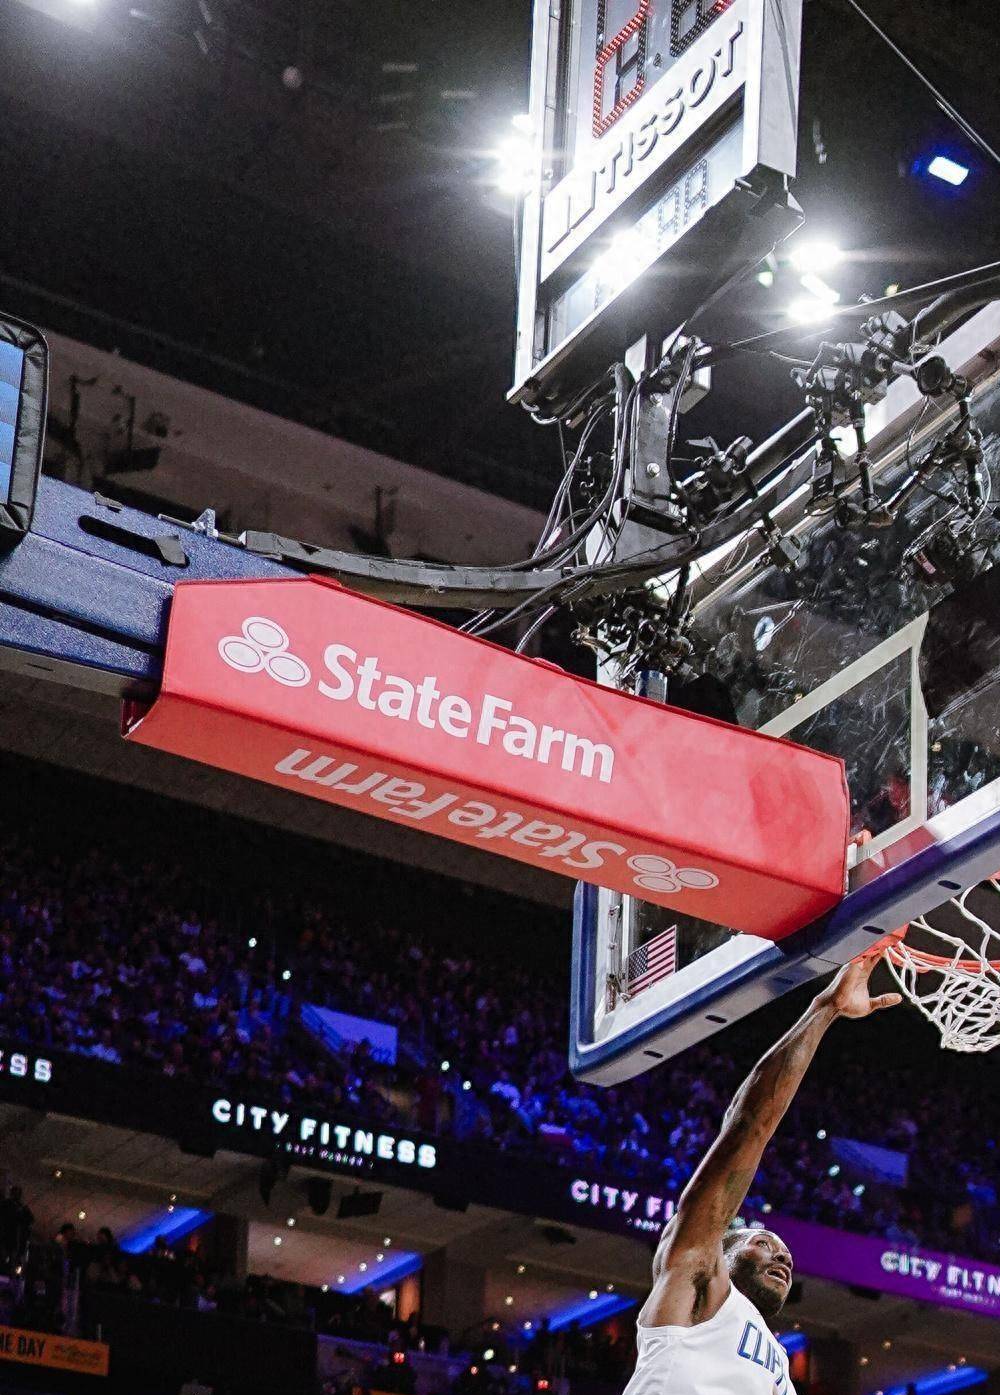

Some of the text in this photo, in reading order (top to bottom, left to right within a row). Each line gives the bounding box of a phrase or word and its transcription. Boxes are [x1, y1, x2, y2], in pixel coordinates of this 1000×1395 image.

[598, 18, 745, 195] TISSOT
[0, 1050, 53, 1081] SS
[212, 1099, 289, 1134] CITY
[301, 1117, 436, 1168] FITNESS
[571, 1179, 675, 1221] CITY FI
[880, 1251, 942, 1282] CITY
[18, 1336, 46, 1358] DAY
